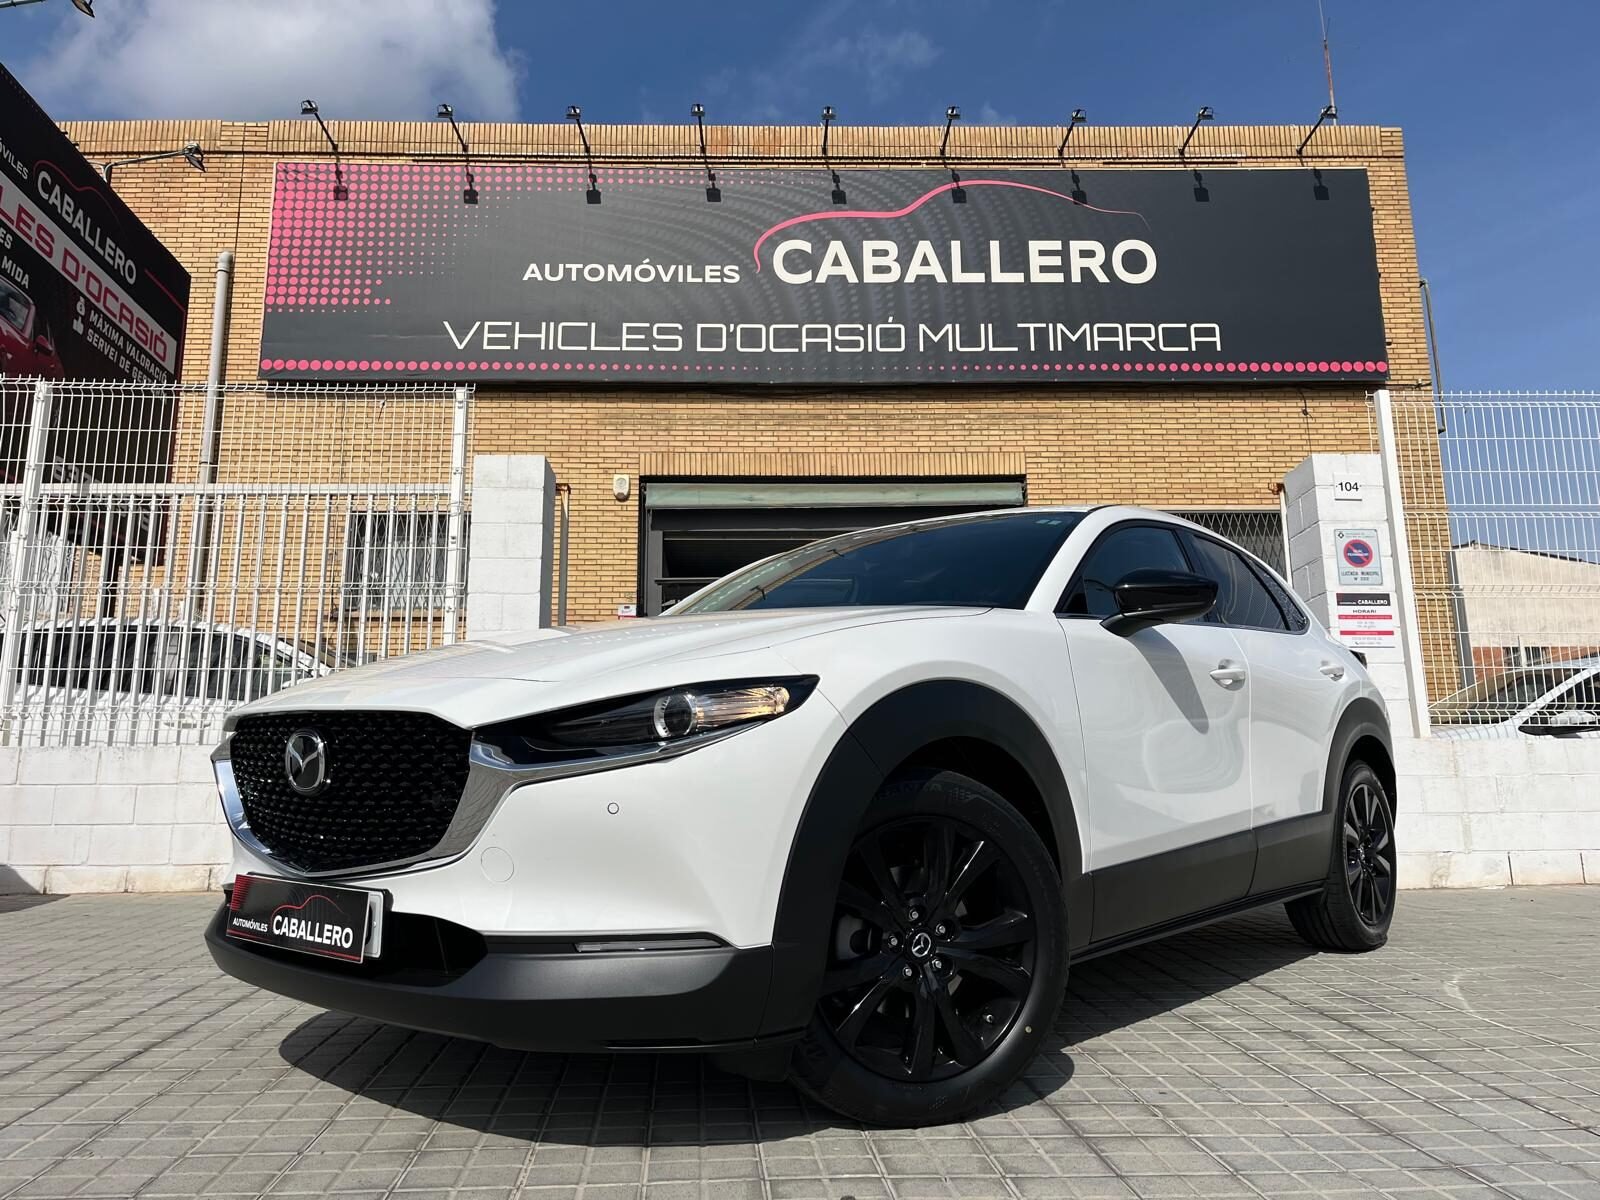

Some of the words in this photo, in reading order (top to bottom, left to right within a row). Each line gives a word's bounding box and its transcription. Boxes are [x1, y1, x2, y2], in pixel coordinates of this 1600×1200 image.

[37, 170, 137, 285] CABALLERO
[1, 255, 30, 289] MIDA
[522, 258, 741, 283] AUTOMÓVILES
[772, 239, 1158, 285] CABALLERO
[61, 246, 168, 363] D'OCASIÓ
[86, 328, 118, 364] SERVEI
[118, 356, 131, 373] DE
[443, 320, 684, 352] VEHICLES
[696, 316, 906, 353] D'OCASIÓ
[918, 323, 1222, 352] MULTIMARCA
[1337, 481, 1360, 492] 104
[232, 917, 268, 933] AUTOMÓVILES
[272, 915, 354, 949] CABALLERO
